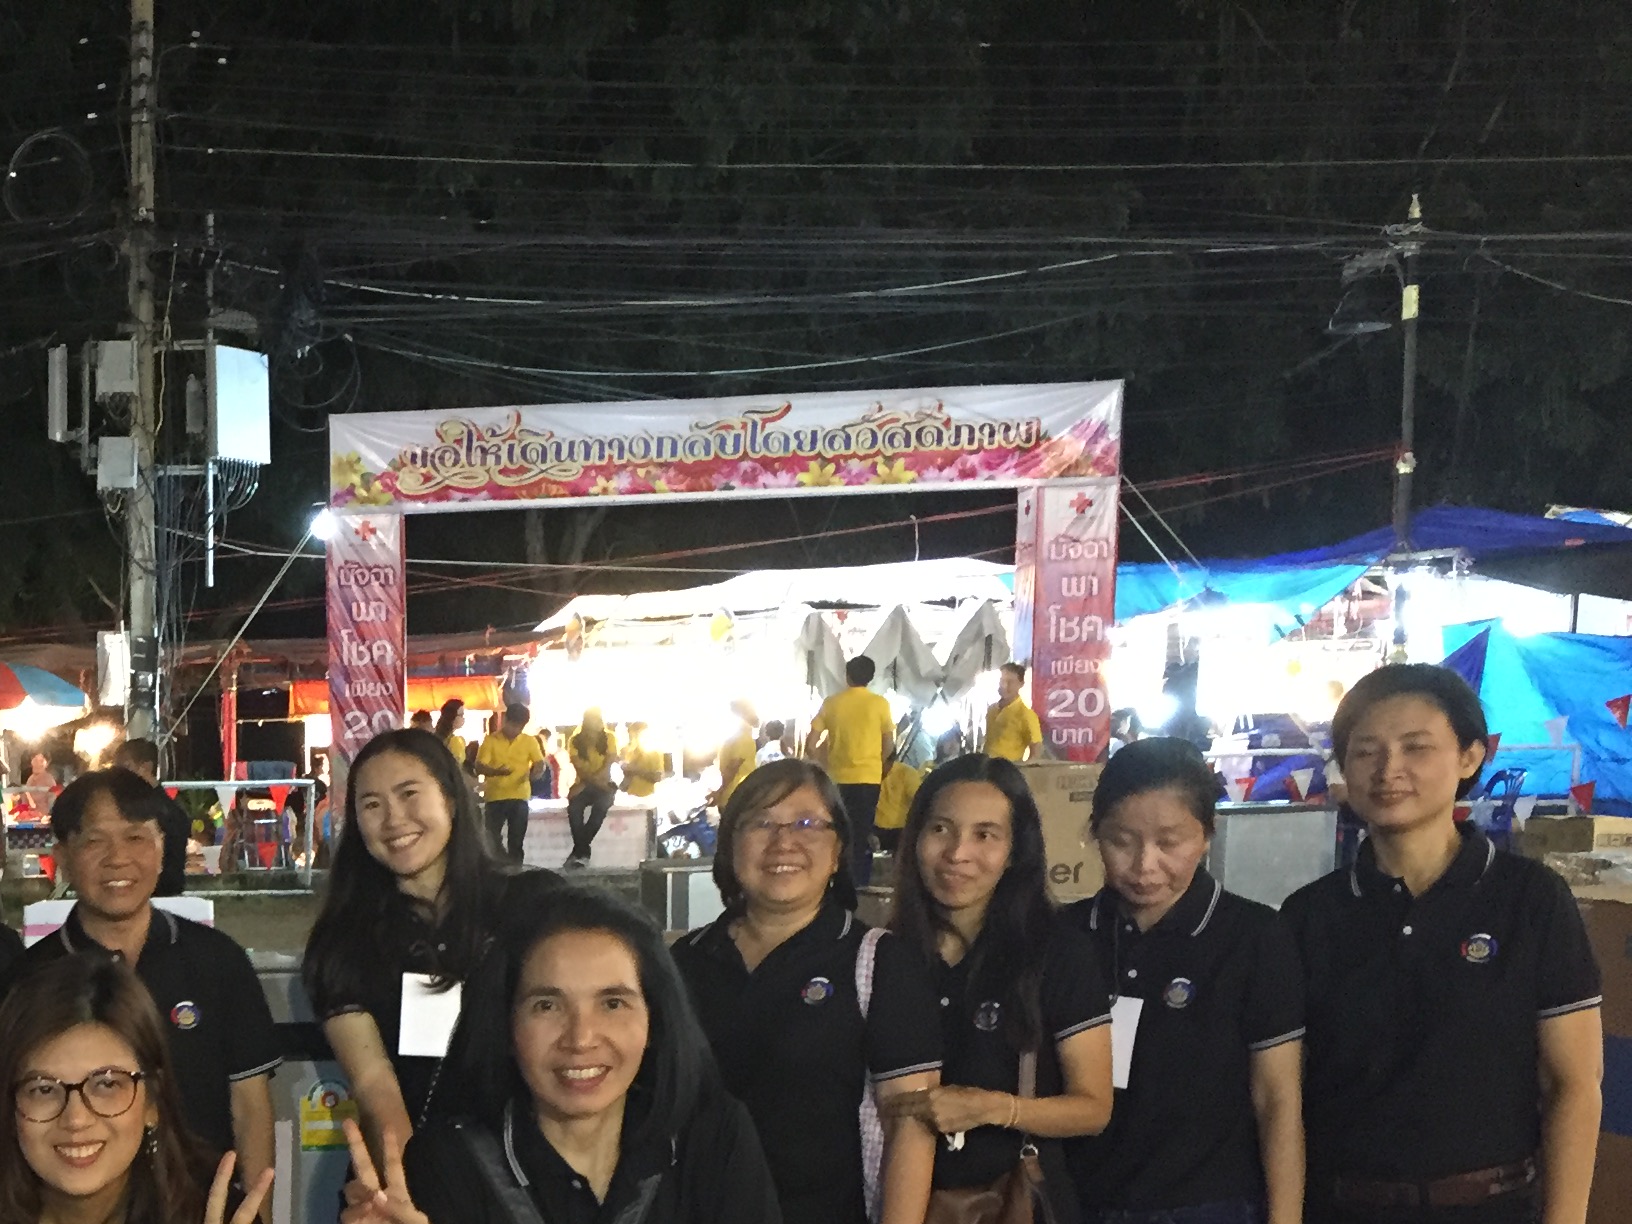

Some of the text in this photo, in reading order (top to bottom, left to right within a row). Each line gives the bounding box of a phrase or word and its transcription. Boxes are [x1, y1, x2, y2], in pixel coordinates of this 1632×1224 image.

[1061, 574, 1099, 597] พา
[1048, 605, 1104, 644] โชค
[340, 628, 395, 667] โชค
[1047, 688, 1105, 718] 20
[343, 709, 398, 740] 20
[1052, 726, 1093, 745] บาท
[1049, 861, 1084, 884] er
